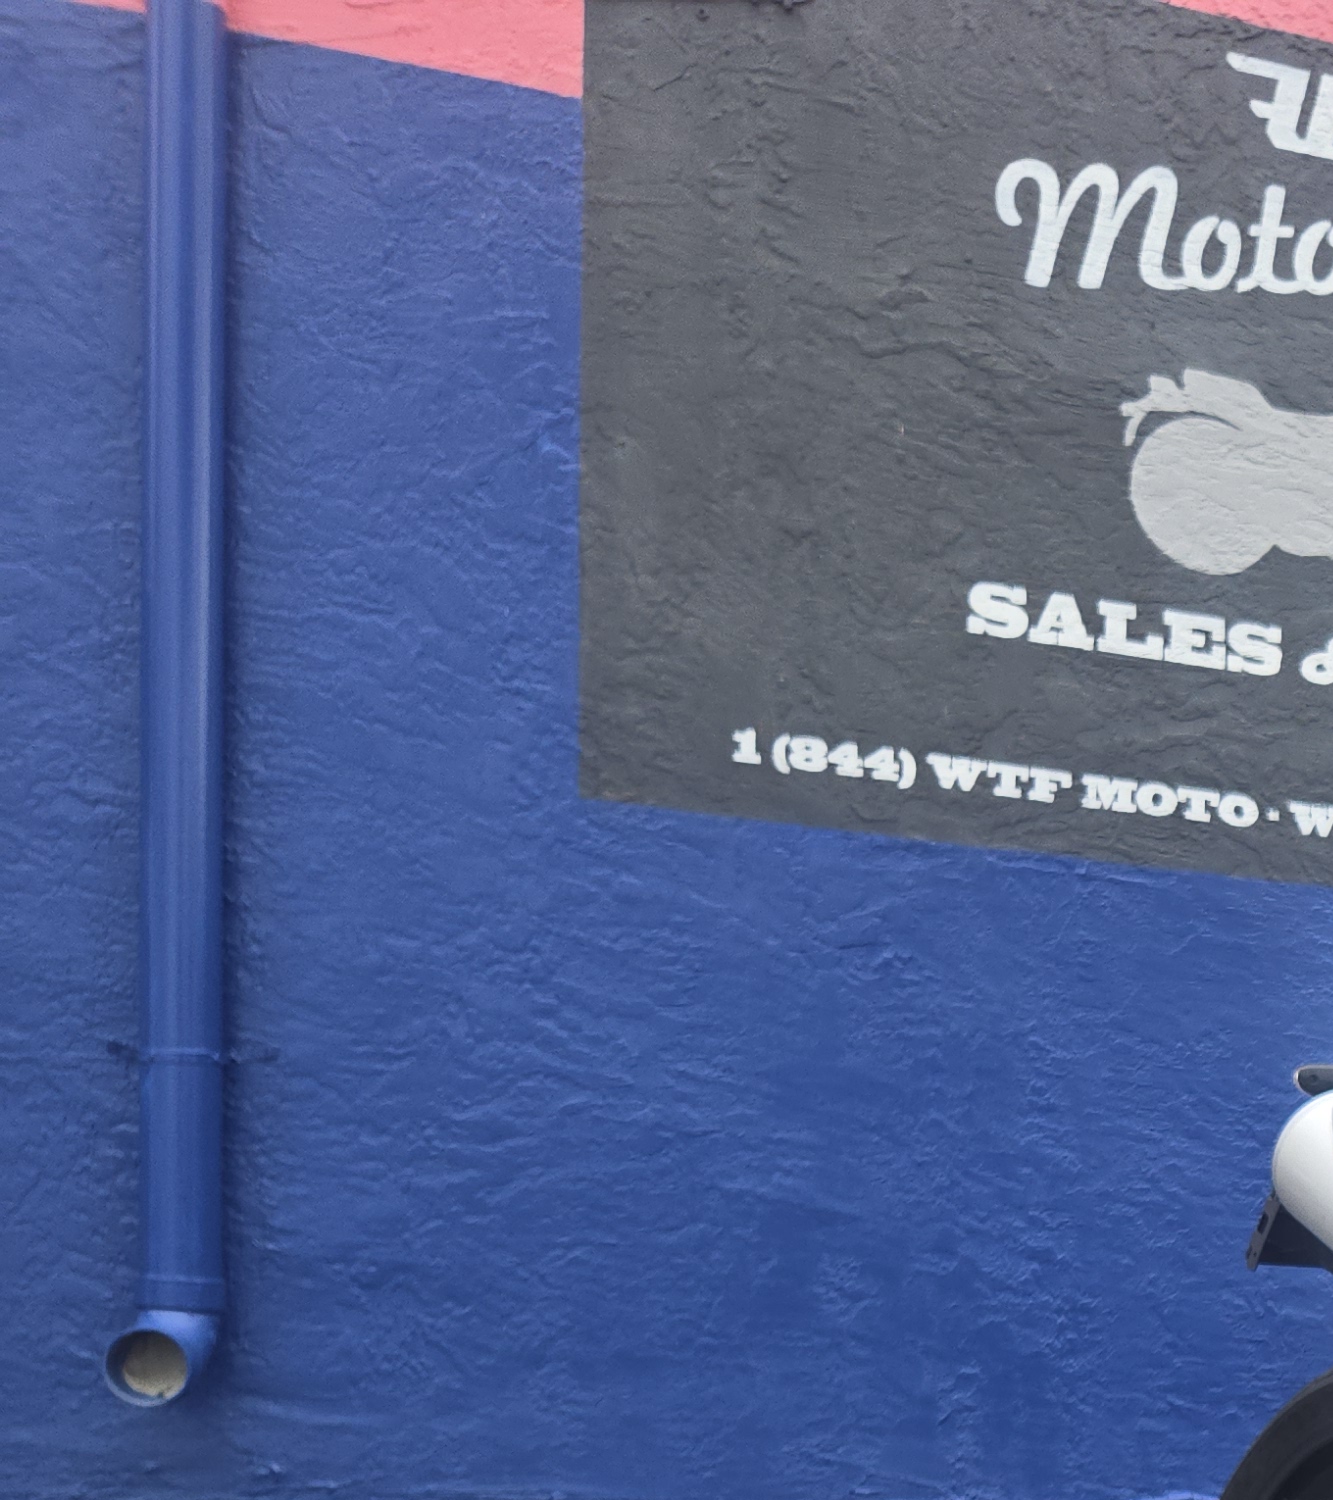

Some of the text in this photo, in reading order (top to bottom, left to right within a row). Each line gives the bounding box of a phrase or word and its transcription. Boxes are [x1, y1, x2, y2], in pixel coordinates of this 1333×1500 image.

[965, 581, 1283, 677] SALES
[731, 725, 762, 765] 1
[771, 732, 917, 790] (844)
[924, 751, 1073, 804] WTF
[1080, 773, 1260, 828] MOTO
